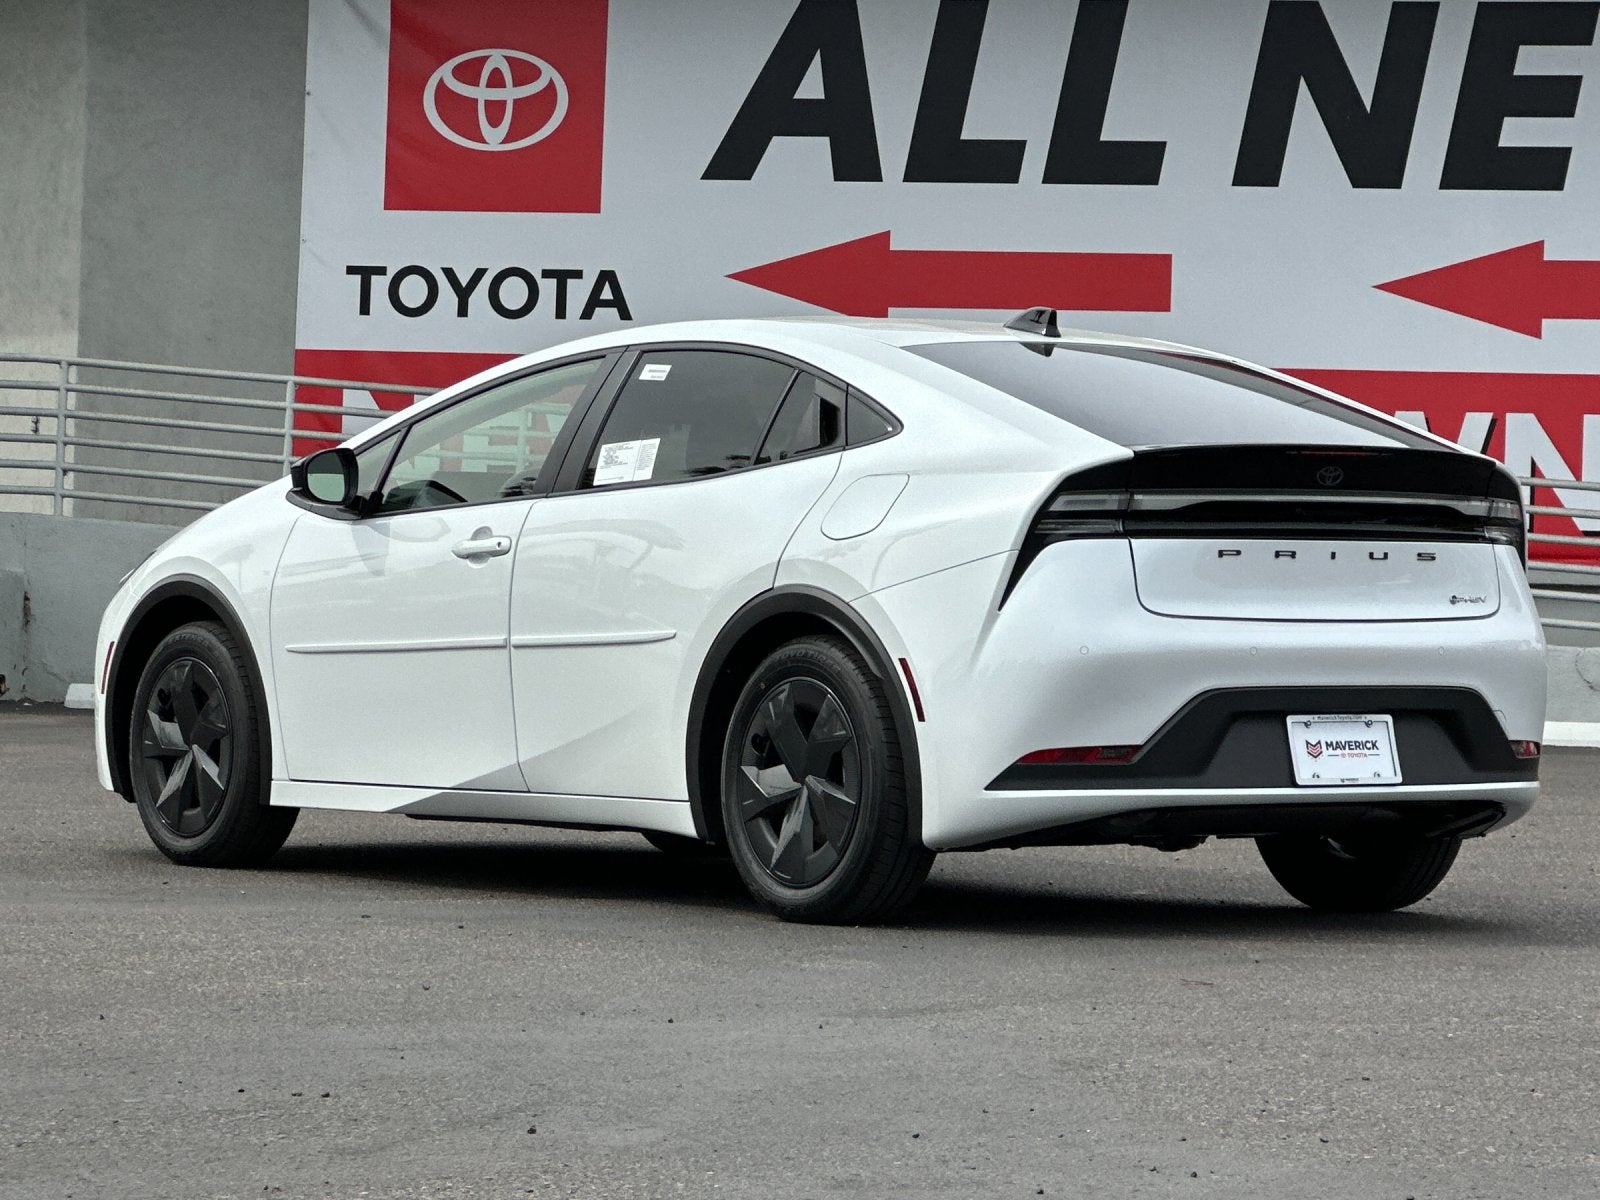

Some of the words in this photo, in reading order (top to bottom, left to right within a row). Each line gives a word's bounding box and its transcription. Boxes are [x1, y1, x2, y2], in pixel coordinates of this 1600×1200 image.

[700, 0, 1167, 185] ALL
[346, 265, 633, 321] TOYOTA
[1217, 549, 1437, 562] PRIUS
[1325, 740, 1379, 751] MAVERICK
